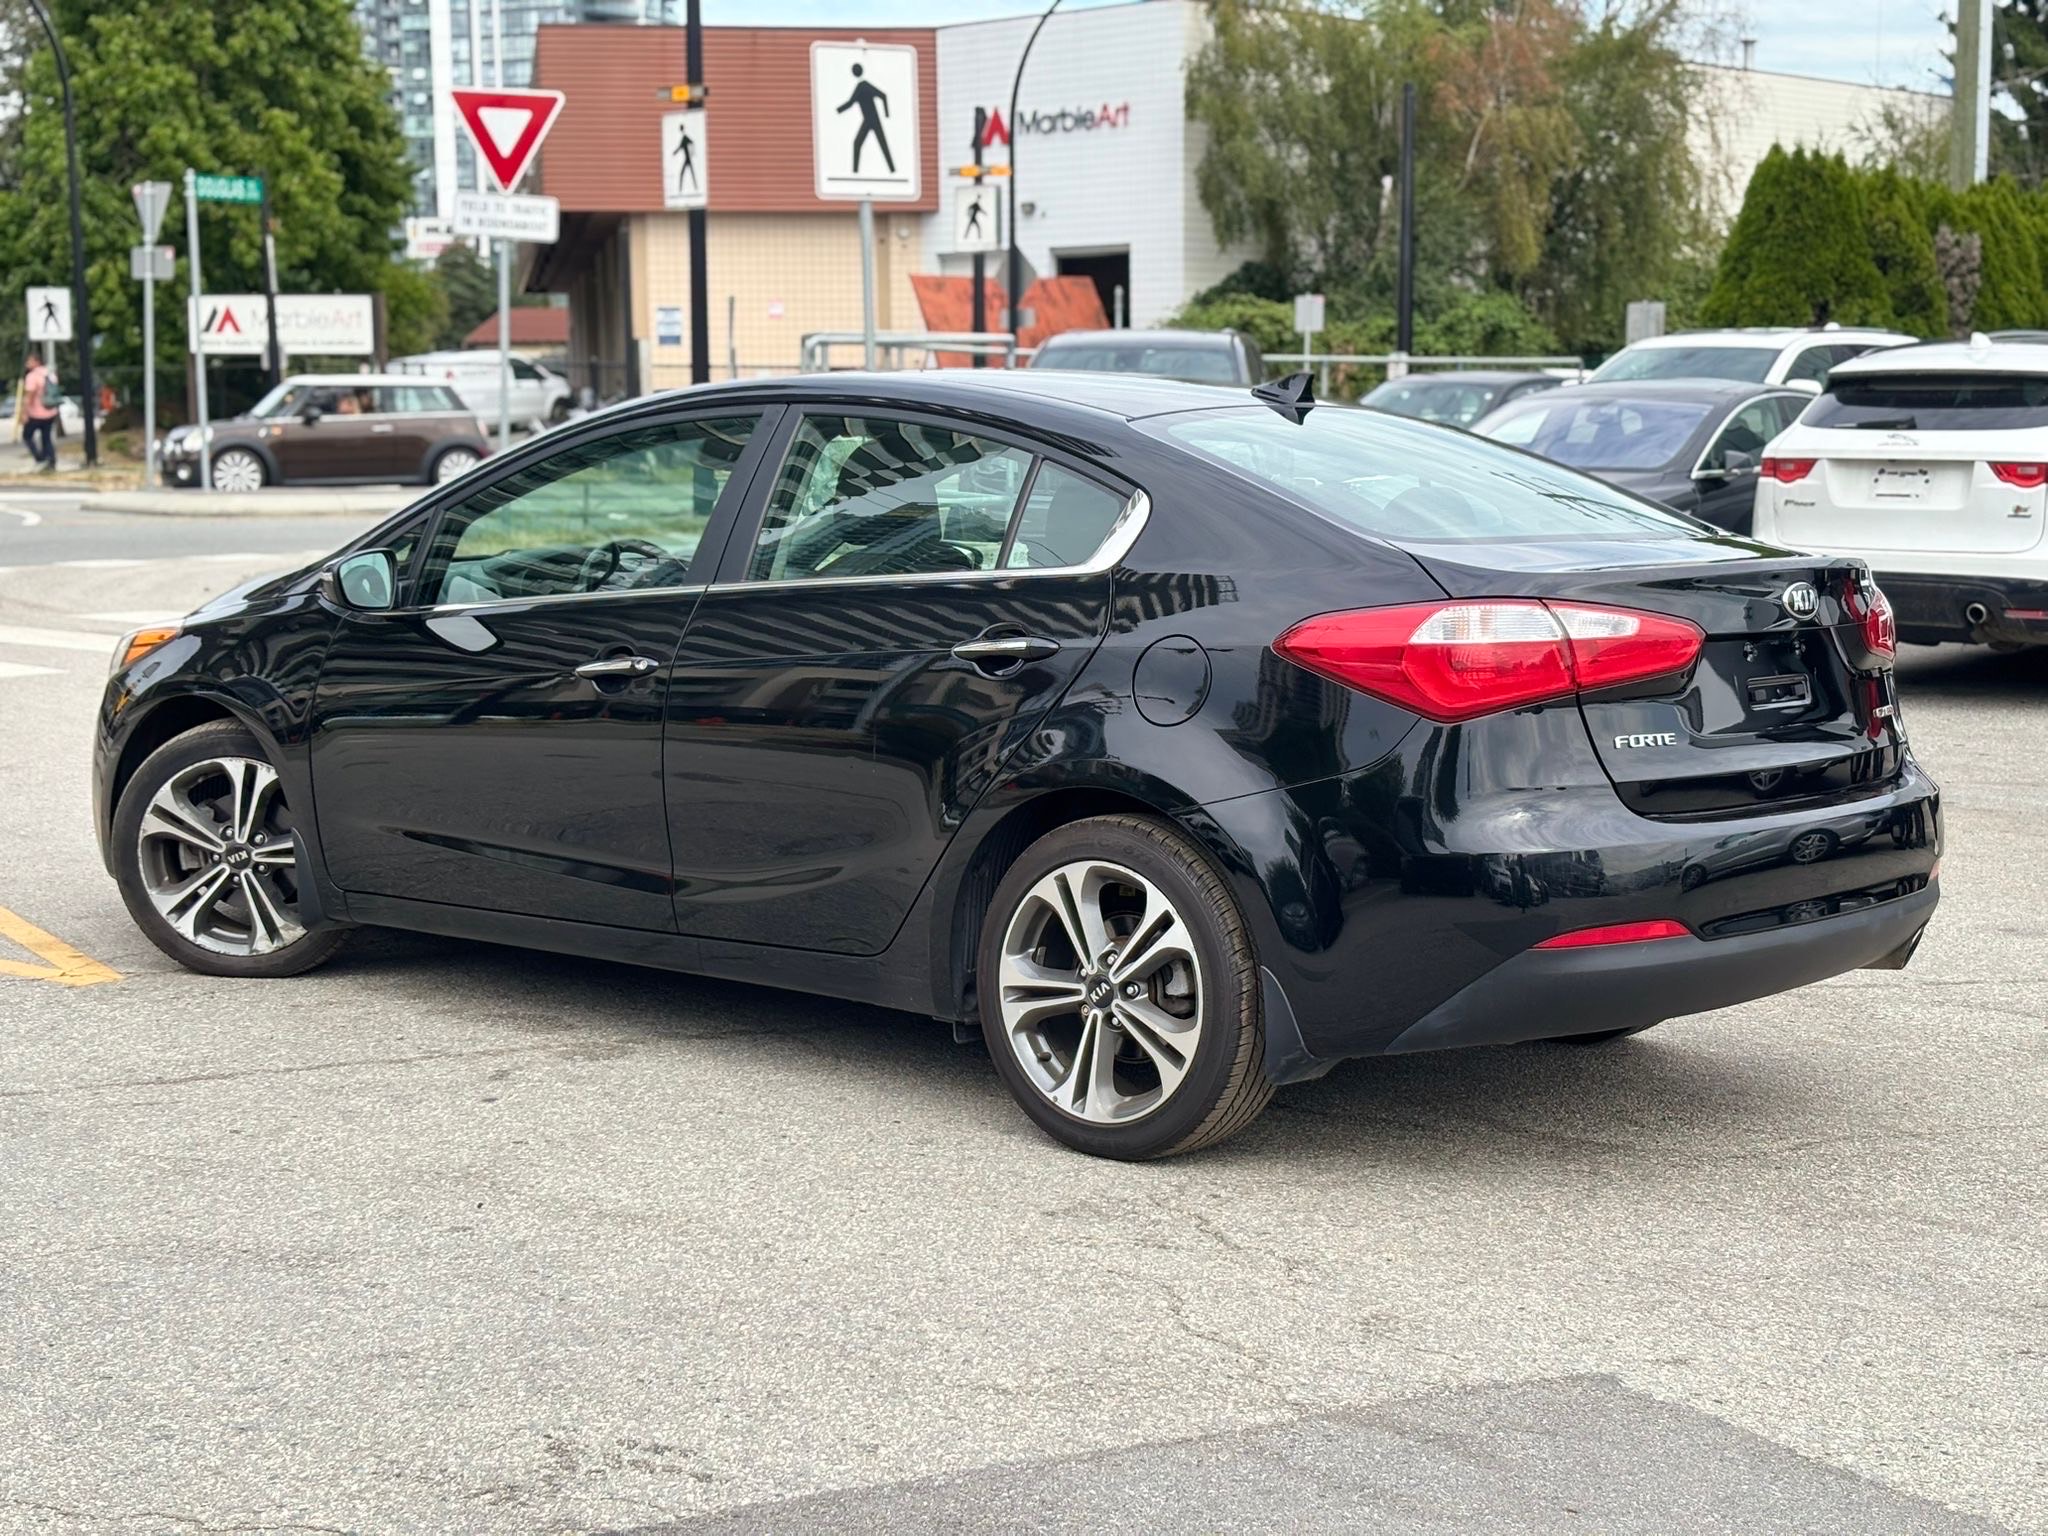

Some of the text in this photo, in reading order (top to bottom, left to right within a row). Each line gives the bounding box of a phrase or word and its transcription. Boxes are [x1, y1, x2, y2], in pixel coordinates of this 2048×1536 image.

[1019, 102, 1129, 135] MarbleArt
[1615, 732, 1677, 749] FORTE
[227, 850, 249, 863] KIA
[1090, 982, 1111, 1003] KIA
